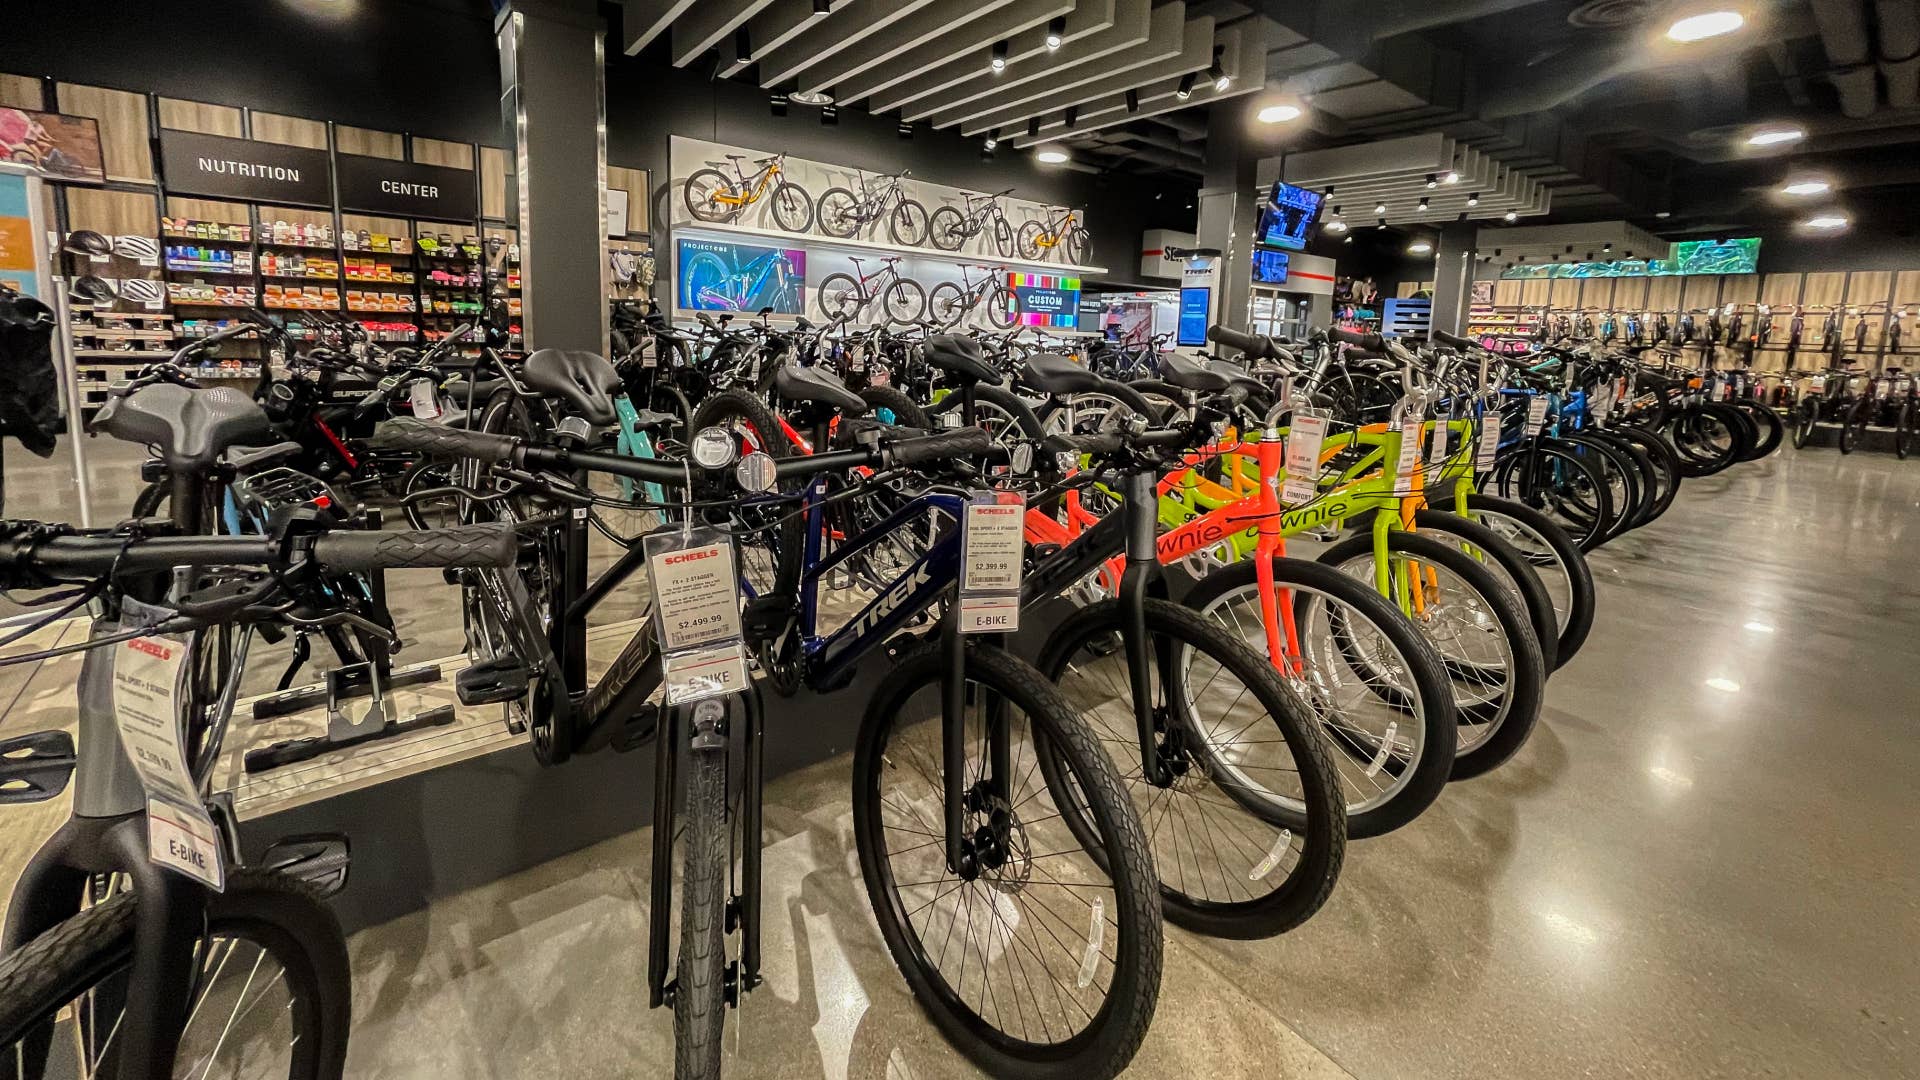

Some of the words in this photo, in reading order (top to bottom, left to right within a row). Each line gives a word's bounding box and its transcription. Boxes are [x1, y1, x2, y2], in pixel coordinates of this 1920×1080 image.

[199, 157, 300, 182] NUTRITION
[381, 180, 439, 198] CENTER
[1028, 295, 1063, 306] CUSTOM
[1286, 491, 1312, 501] COMFORT
[665, 549, 719, 566] SCHEELS
[850, 559, 932, 638] TREK
[976, 615, 1007, 626] E-BIKE
[128, 638, 172, 661] SCHEELS
[688, 671, 730, 690] EBIKE
[169, 839, 205, 869] E-BIKE
